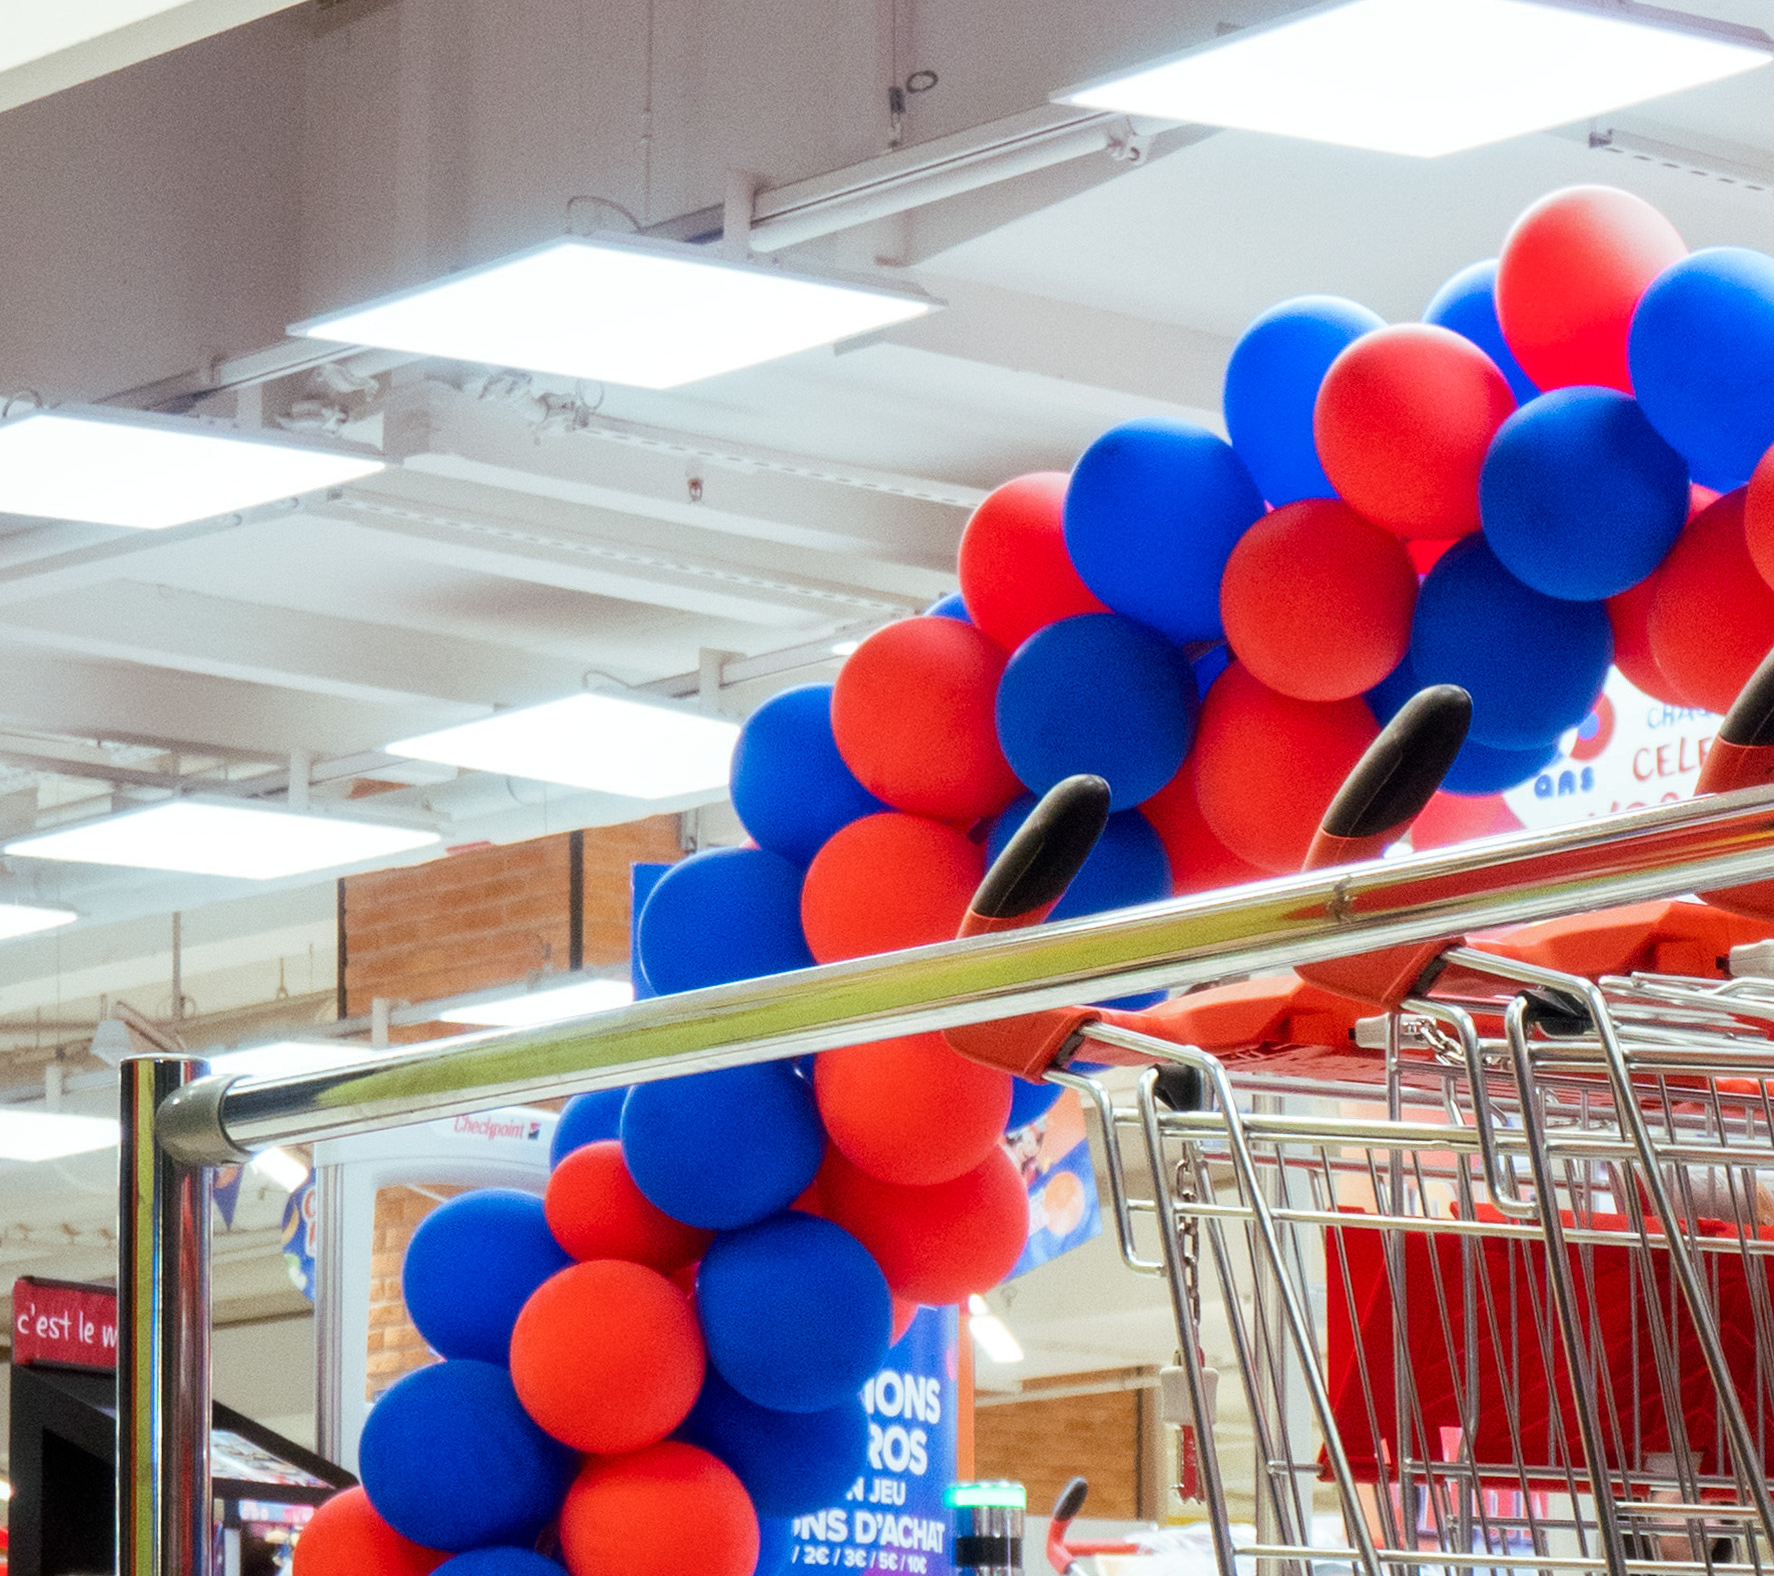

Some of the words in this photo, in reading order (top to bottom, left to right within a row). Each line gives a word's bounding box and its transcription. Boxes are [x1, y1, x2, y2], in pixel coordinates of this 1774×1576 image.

[454, 1114, 524, 1140] Checkpoint
[17, 1303, 72, 1341] c'est
[79, 1310, 94, 1344] le
[861, 1369, 942, 1425] IONS
[868, 1478, 906, 1506] JEU
[792, 1507, 848, 1543] NS
[855, 1509, 946, 1554] D'ACHAT
[803, 1545, 830, 1565] 2€
[844, 1549, 867, 1568] 3€
[879, 1551, 899, 1571] 5€
[908, 1555, 928, 1575] 10€
